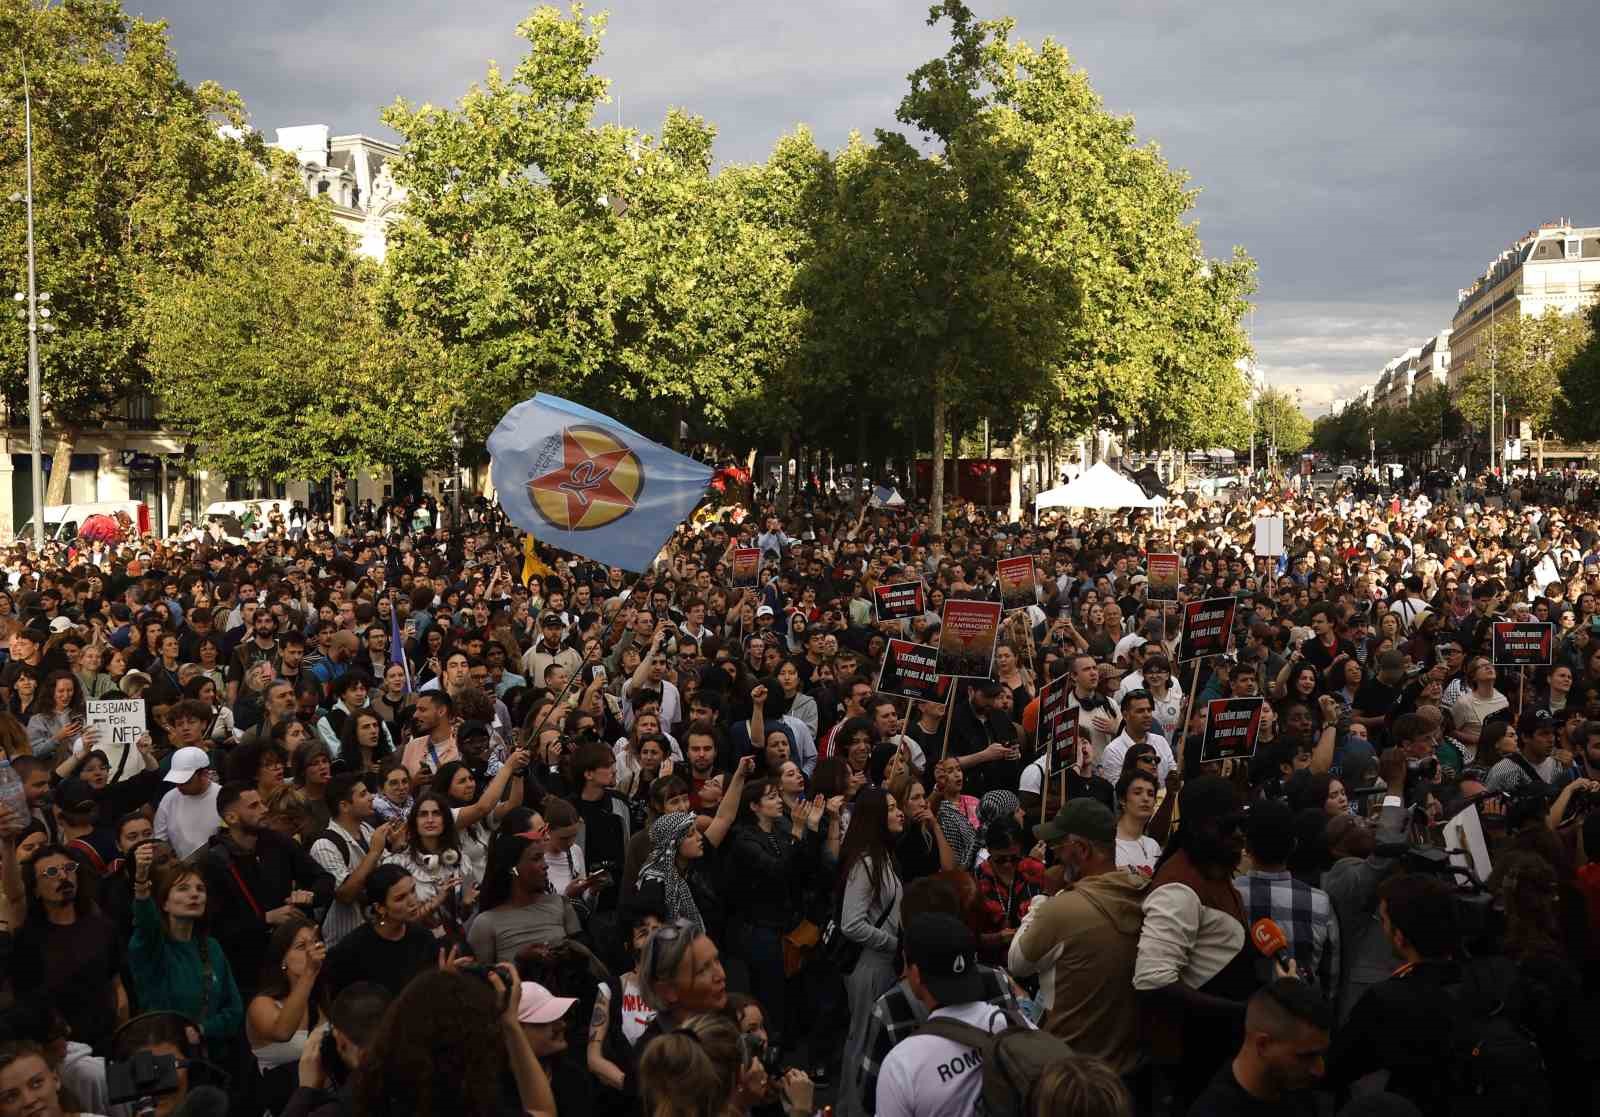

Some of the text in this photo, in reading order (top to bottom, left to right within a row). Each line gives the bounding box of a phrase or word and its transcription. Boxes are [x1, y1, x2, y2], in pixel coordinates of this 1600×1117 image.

[88, 701, 139, 713] LESBIANS
[109, 715, 126, 725] FOR
[113, 726, 141, 743] NFP
